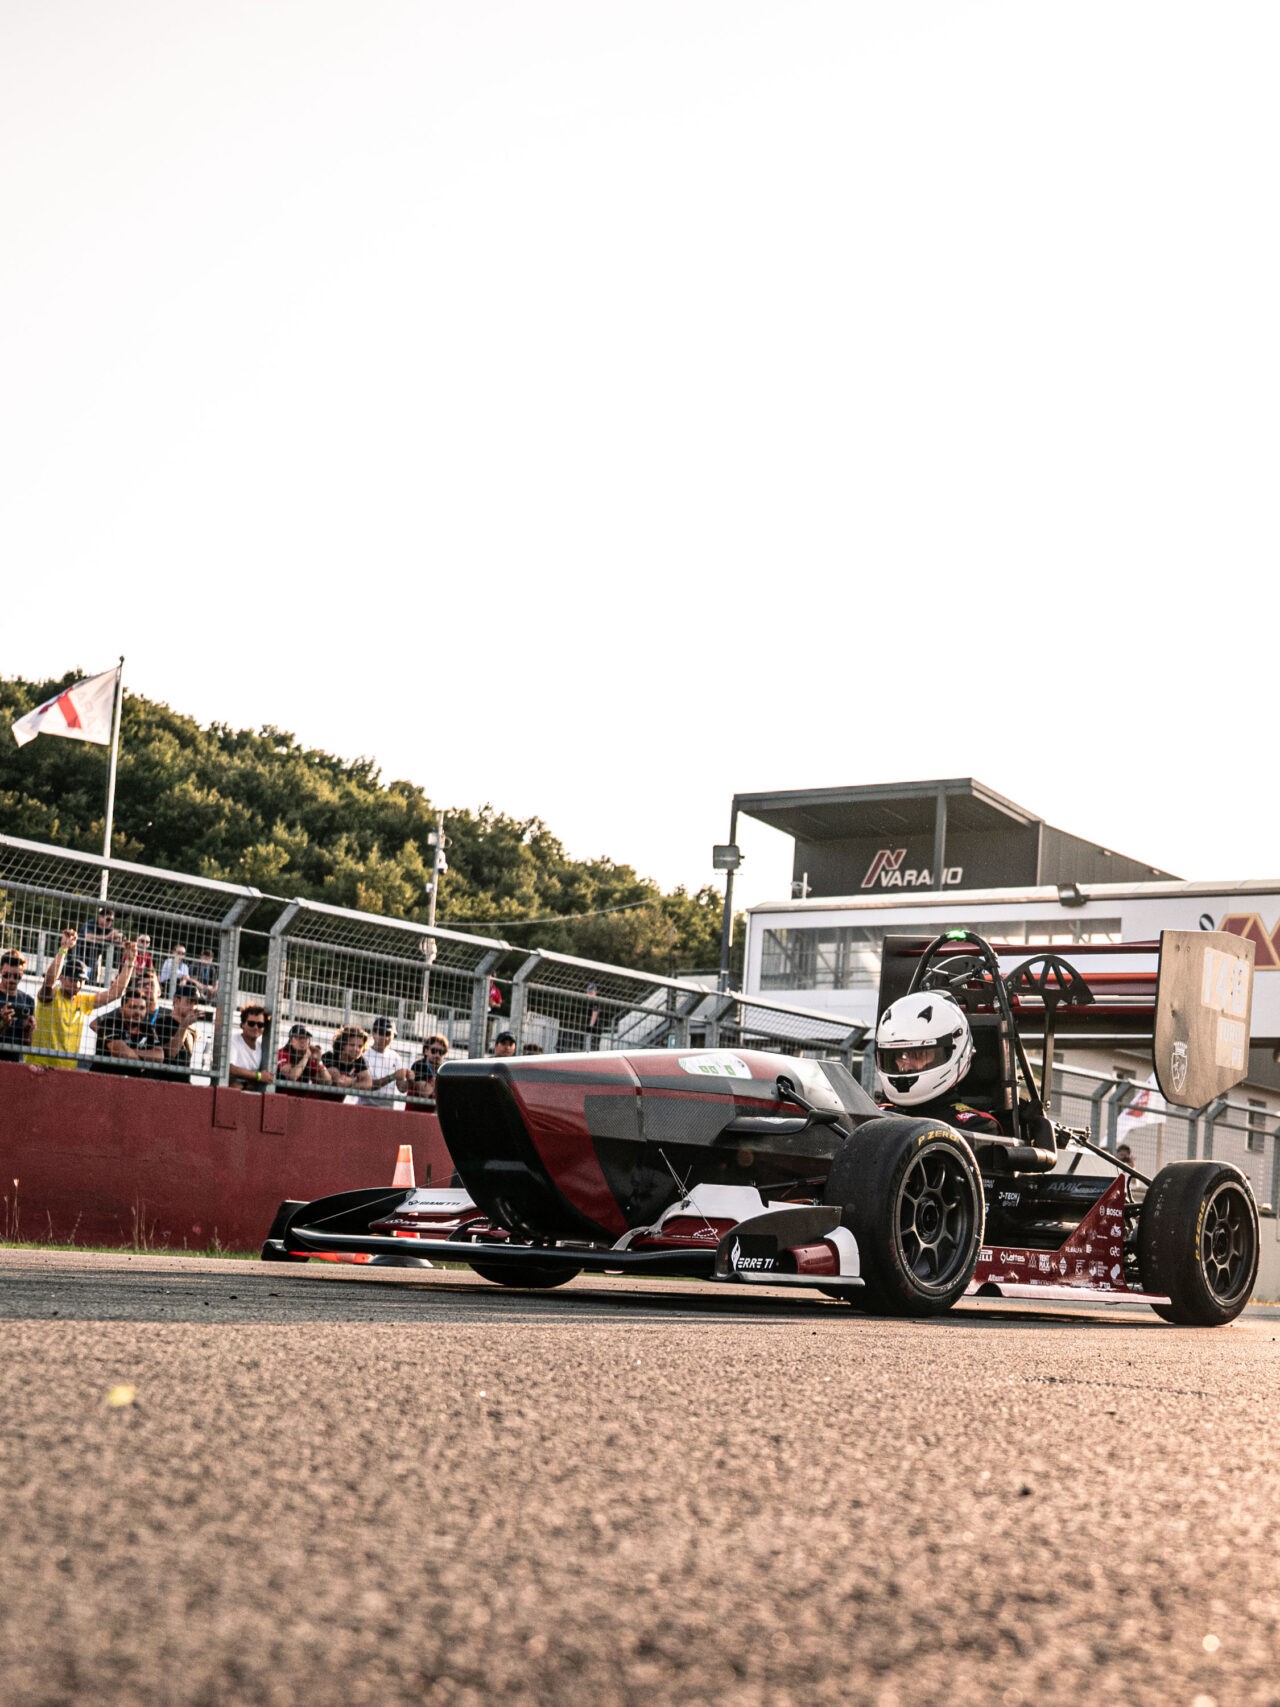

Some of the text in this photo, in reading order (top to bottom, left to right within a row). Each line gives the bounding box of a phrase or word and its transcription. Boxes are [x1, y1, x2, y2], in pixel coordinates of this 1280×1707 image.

[918, 1130, 960, 1146] P ZERO
[1106, 1207, 1122, 1216] BOSCH
[738, 1257, 774, 1269] ERRE TI
